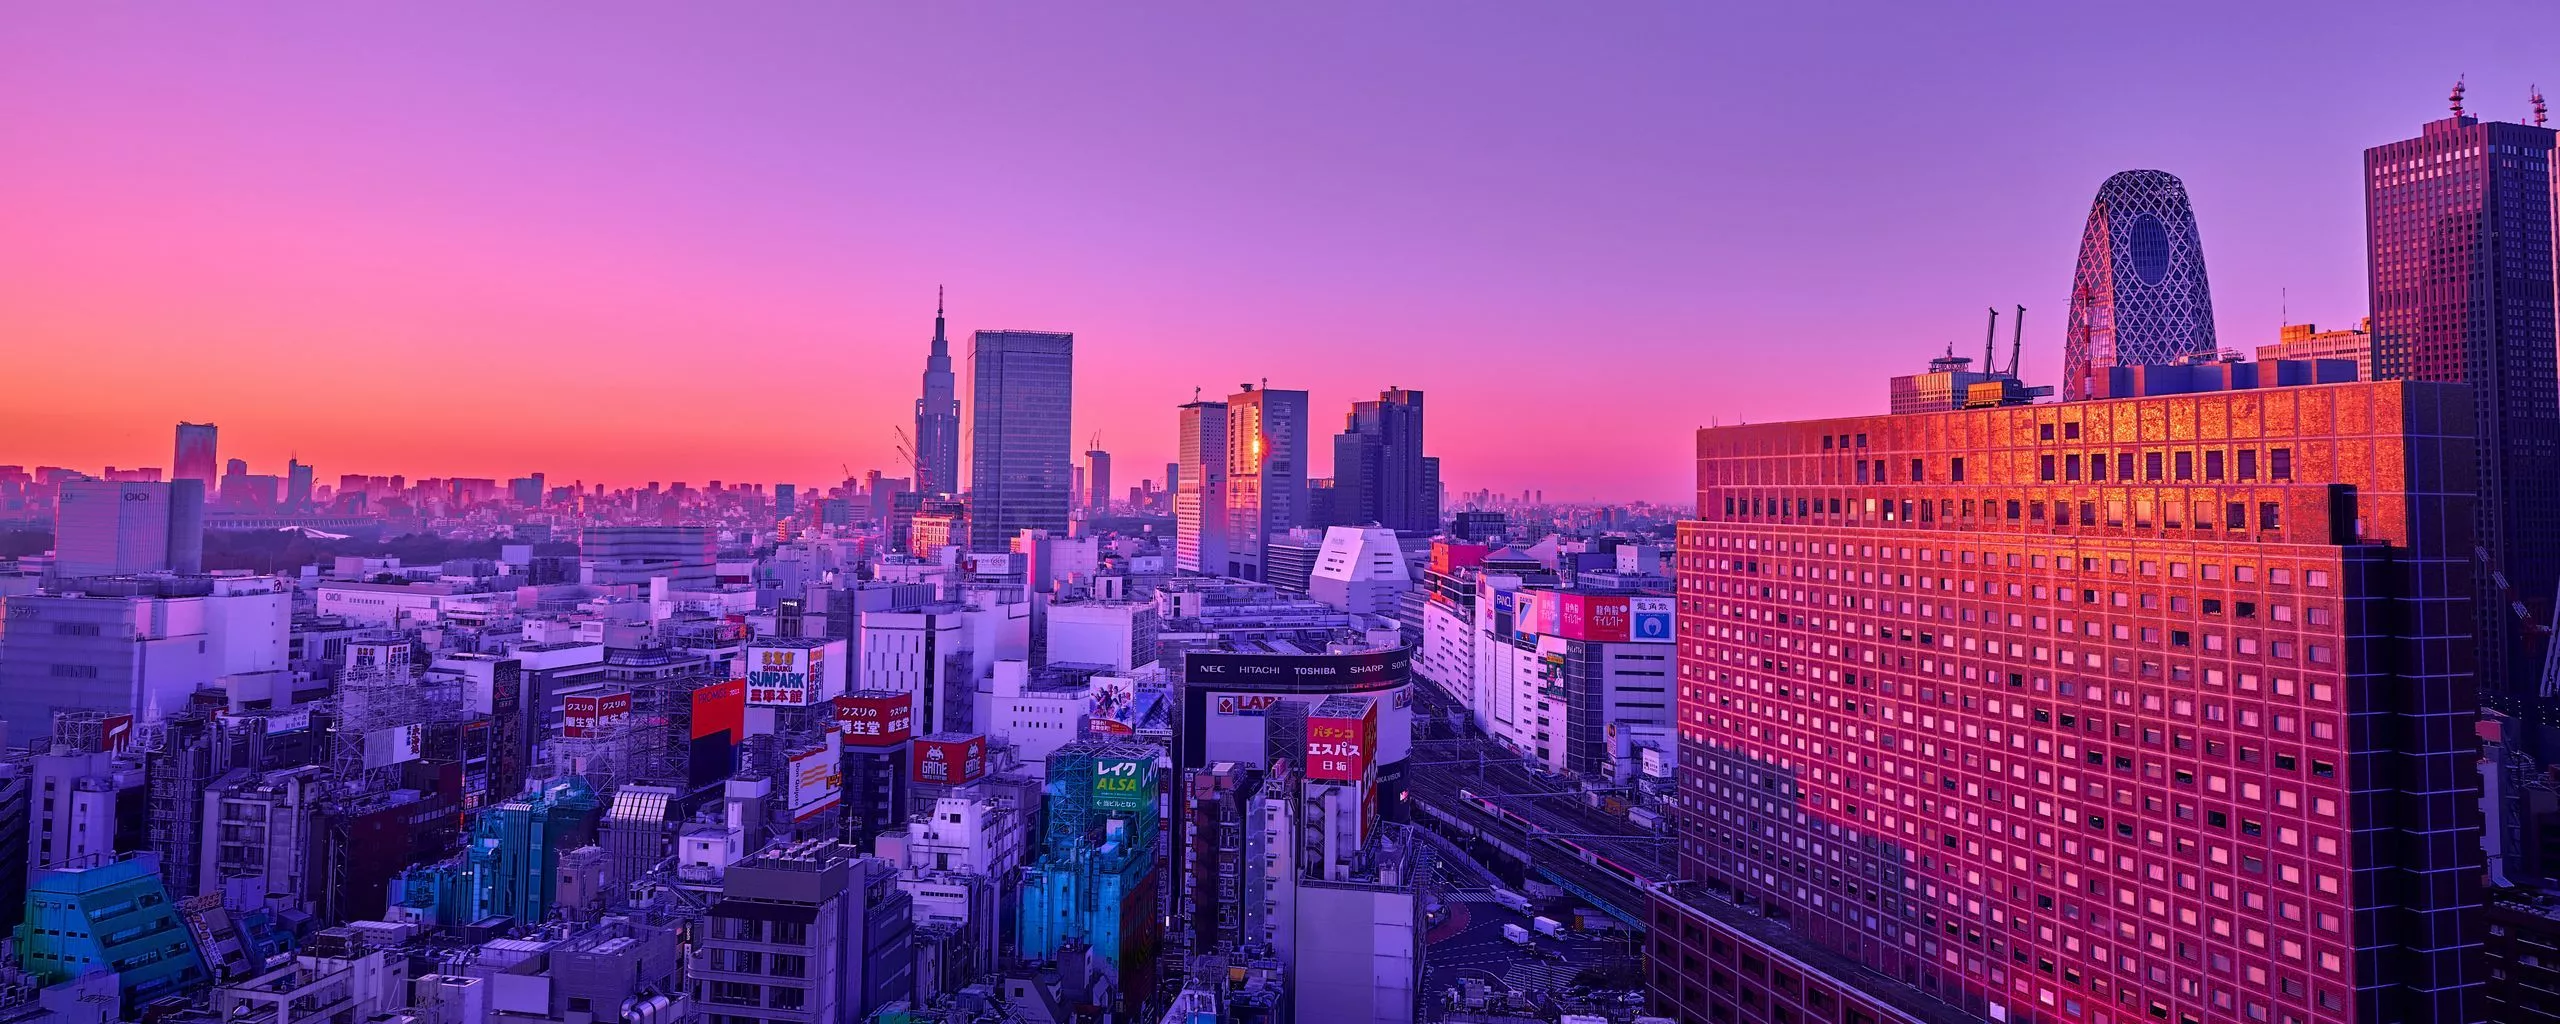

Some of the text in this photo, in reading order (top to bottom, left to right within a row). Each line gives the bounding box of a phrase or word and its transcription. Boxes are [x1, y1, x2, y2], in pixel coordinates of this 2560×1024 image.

[1200, 665, 1226, 673] NEC
[1239, 666, 1280, 674] HITACHI
[1294, 667, 1336, 675] TOSHIBA
[1350, 664, 1384, 674] SHARP
[749, 671, 804, 688] SUNPARK
[567, 703, 594, 711] クスリの
[602, 700, 627, 711] クスリの
[1238, 695, 1278, 710] LA
[842, 707, 877, 717] クスリの
[890, 706, 908, 717] クスリの
[1313, 726, 1354, 739] パチンコ
[1308, 741, 1360, 757] エスパス
[922, 760, 947, 776] GAME
[1098, 761, 1136, 776] レイク
[1097, 778, 1136, 792] ALSA
